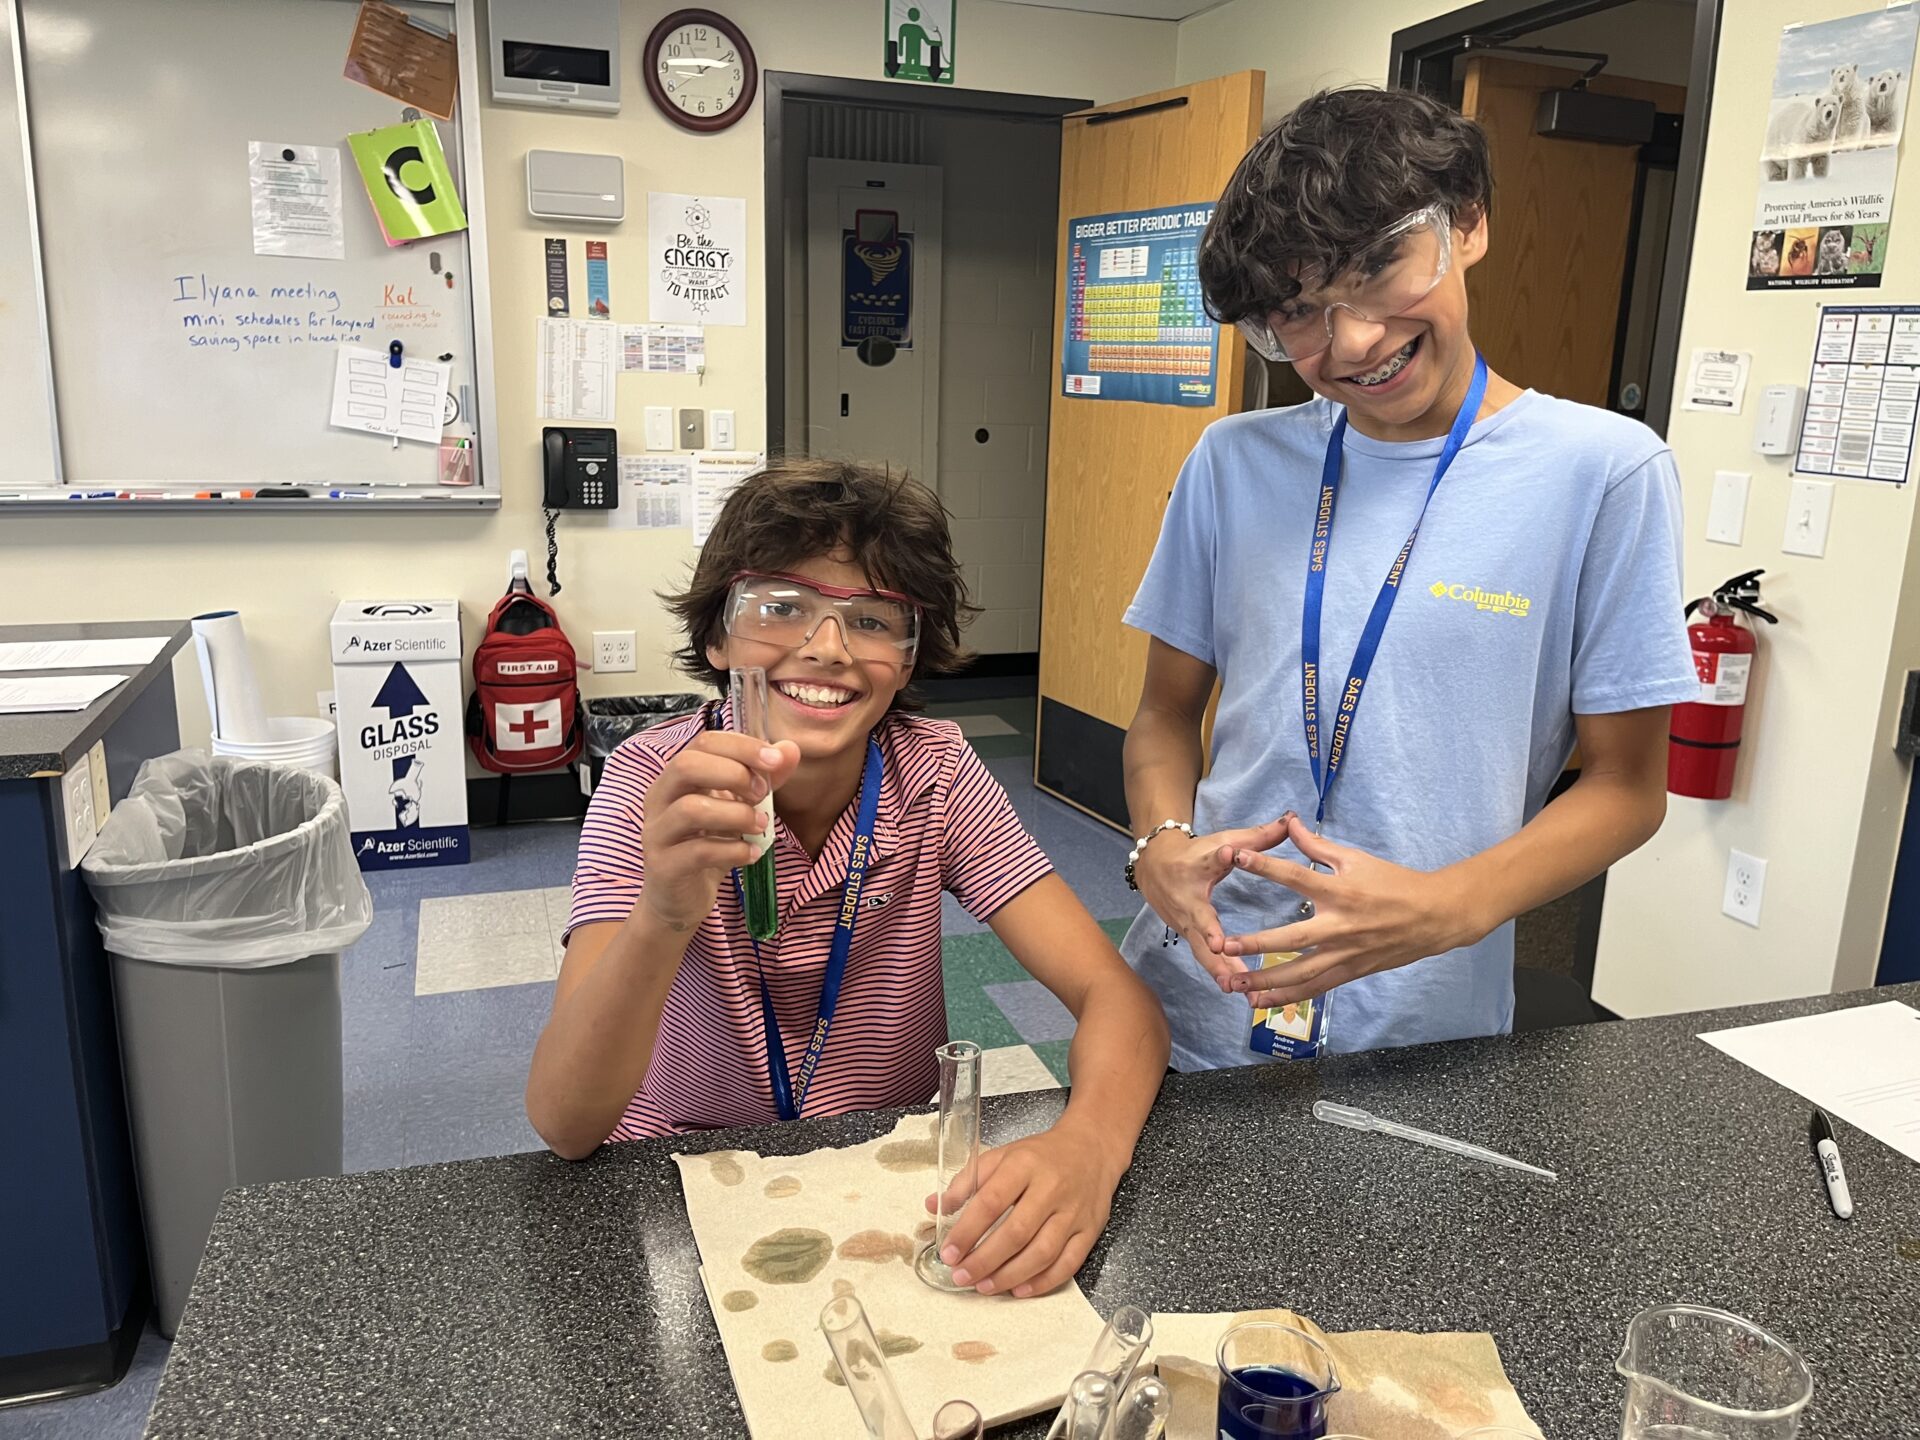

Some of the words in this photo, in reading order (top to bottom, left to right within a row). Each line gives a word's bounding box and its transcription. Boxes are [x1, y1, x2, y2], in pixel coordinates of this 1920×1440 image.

[679, 32, 691, 45] 11
[694, 28, 707, 41] 12
[716, 36, 721, 48] 1
[667, 44, 681, 57] 10
[727, 50, 735, 63] 2
[661, 61, 669, 74] 9
[733, 69, 741, 81] 3
[667, 80, 676, 92] 8
[727, 86, 735, 98] 4
[680, 95, 687, 107] 7
[697, 101, 705, 113] 6
[715, 98, 723, 110] 5
[1763, 201, 1806, 212] Protecting
[1808, 197, 1848, 209] America's
[1850, 194, 1885, 206] Wildlife
[1106, 219, 1139, 236] BETTER
[1140, 213, 1182, 232] PERIODIC
[1764, 216, 1779, 225] and
[1781, 215, 1801, 225] Wild
[1803, 213, 1828, 224] Places
[1830, 210, 1843, 221] for
[1844, 211, 1855, 220] 86
[1857, 209, 1880, 220] Years
[677, 233, 693, 248] Be
[697, 234, 715, 248] the
[664, 248, 730, 269] ENERGY
[691, 270, 706, 278] YOU
[173, 273, 259, 307] Ilyana
[270, 282, 341, 312] meeting
[667, 281, 681, 296] TO
[683, 284, 730, 301] ATTRACT
[183, 314, 225, 327] mini
[235, 313, 301, 327] schedules
[308, 311, 327, 327] for
[331, 314, 375, 331] lanyard
[189, 332, 240, 351] saving
[289, 333, 303, 343] in
[308, 332, 337, 343] lunch
[340, 332, 361, 343] line
[1316, 485, 1334, 538] STUDENT
[1311, 540, 1327, 572] SAES
[1447, 583, 1531, 610] Columbia
[363, 640, 392, 652] Azer
[394, 638, 446, 651] Scientific
[500, 664, 533, 672] FIRST
[536, 663, 555, 671] AID
[1304, 662, 1316, 721] STUDENT
[1342, 677, 1362, 712] SAES
[361, 712, 439, 749] GLASS
[373, 738, 432, 761] DISPOSAL
[1307, 724, 1318, 758] SAES
[1329, 714, 1350, 773] STUDENT
[377, 841, 406, 853] Azer
[407, 836, 459, 851] Scientific
[851, 834, 869, 869] SAES
[838, 871, 862, 930] STUDENT
[810, 1017, 829, 1052] SAES
[1273, 1035, 1295, 1045] Andrew
[1272, 1049, 1292, 1060] Student
